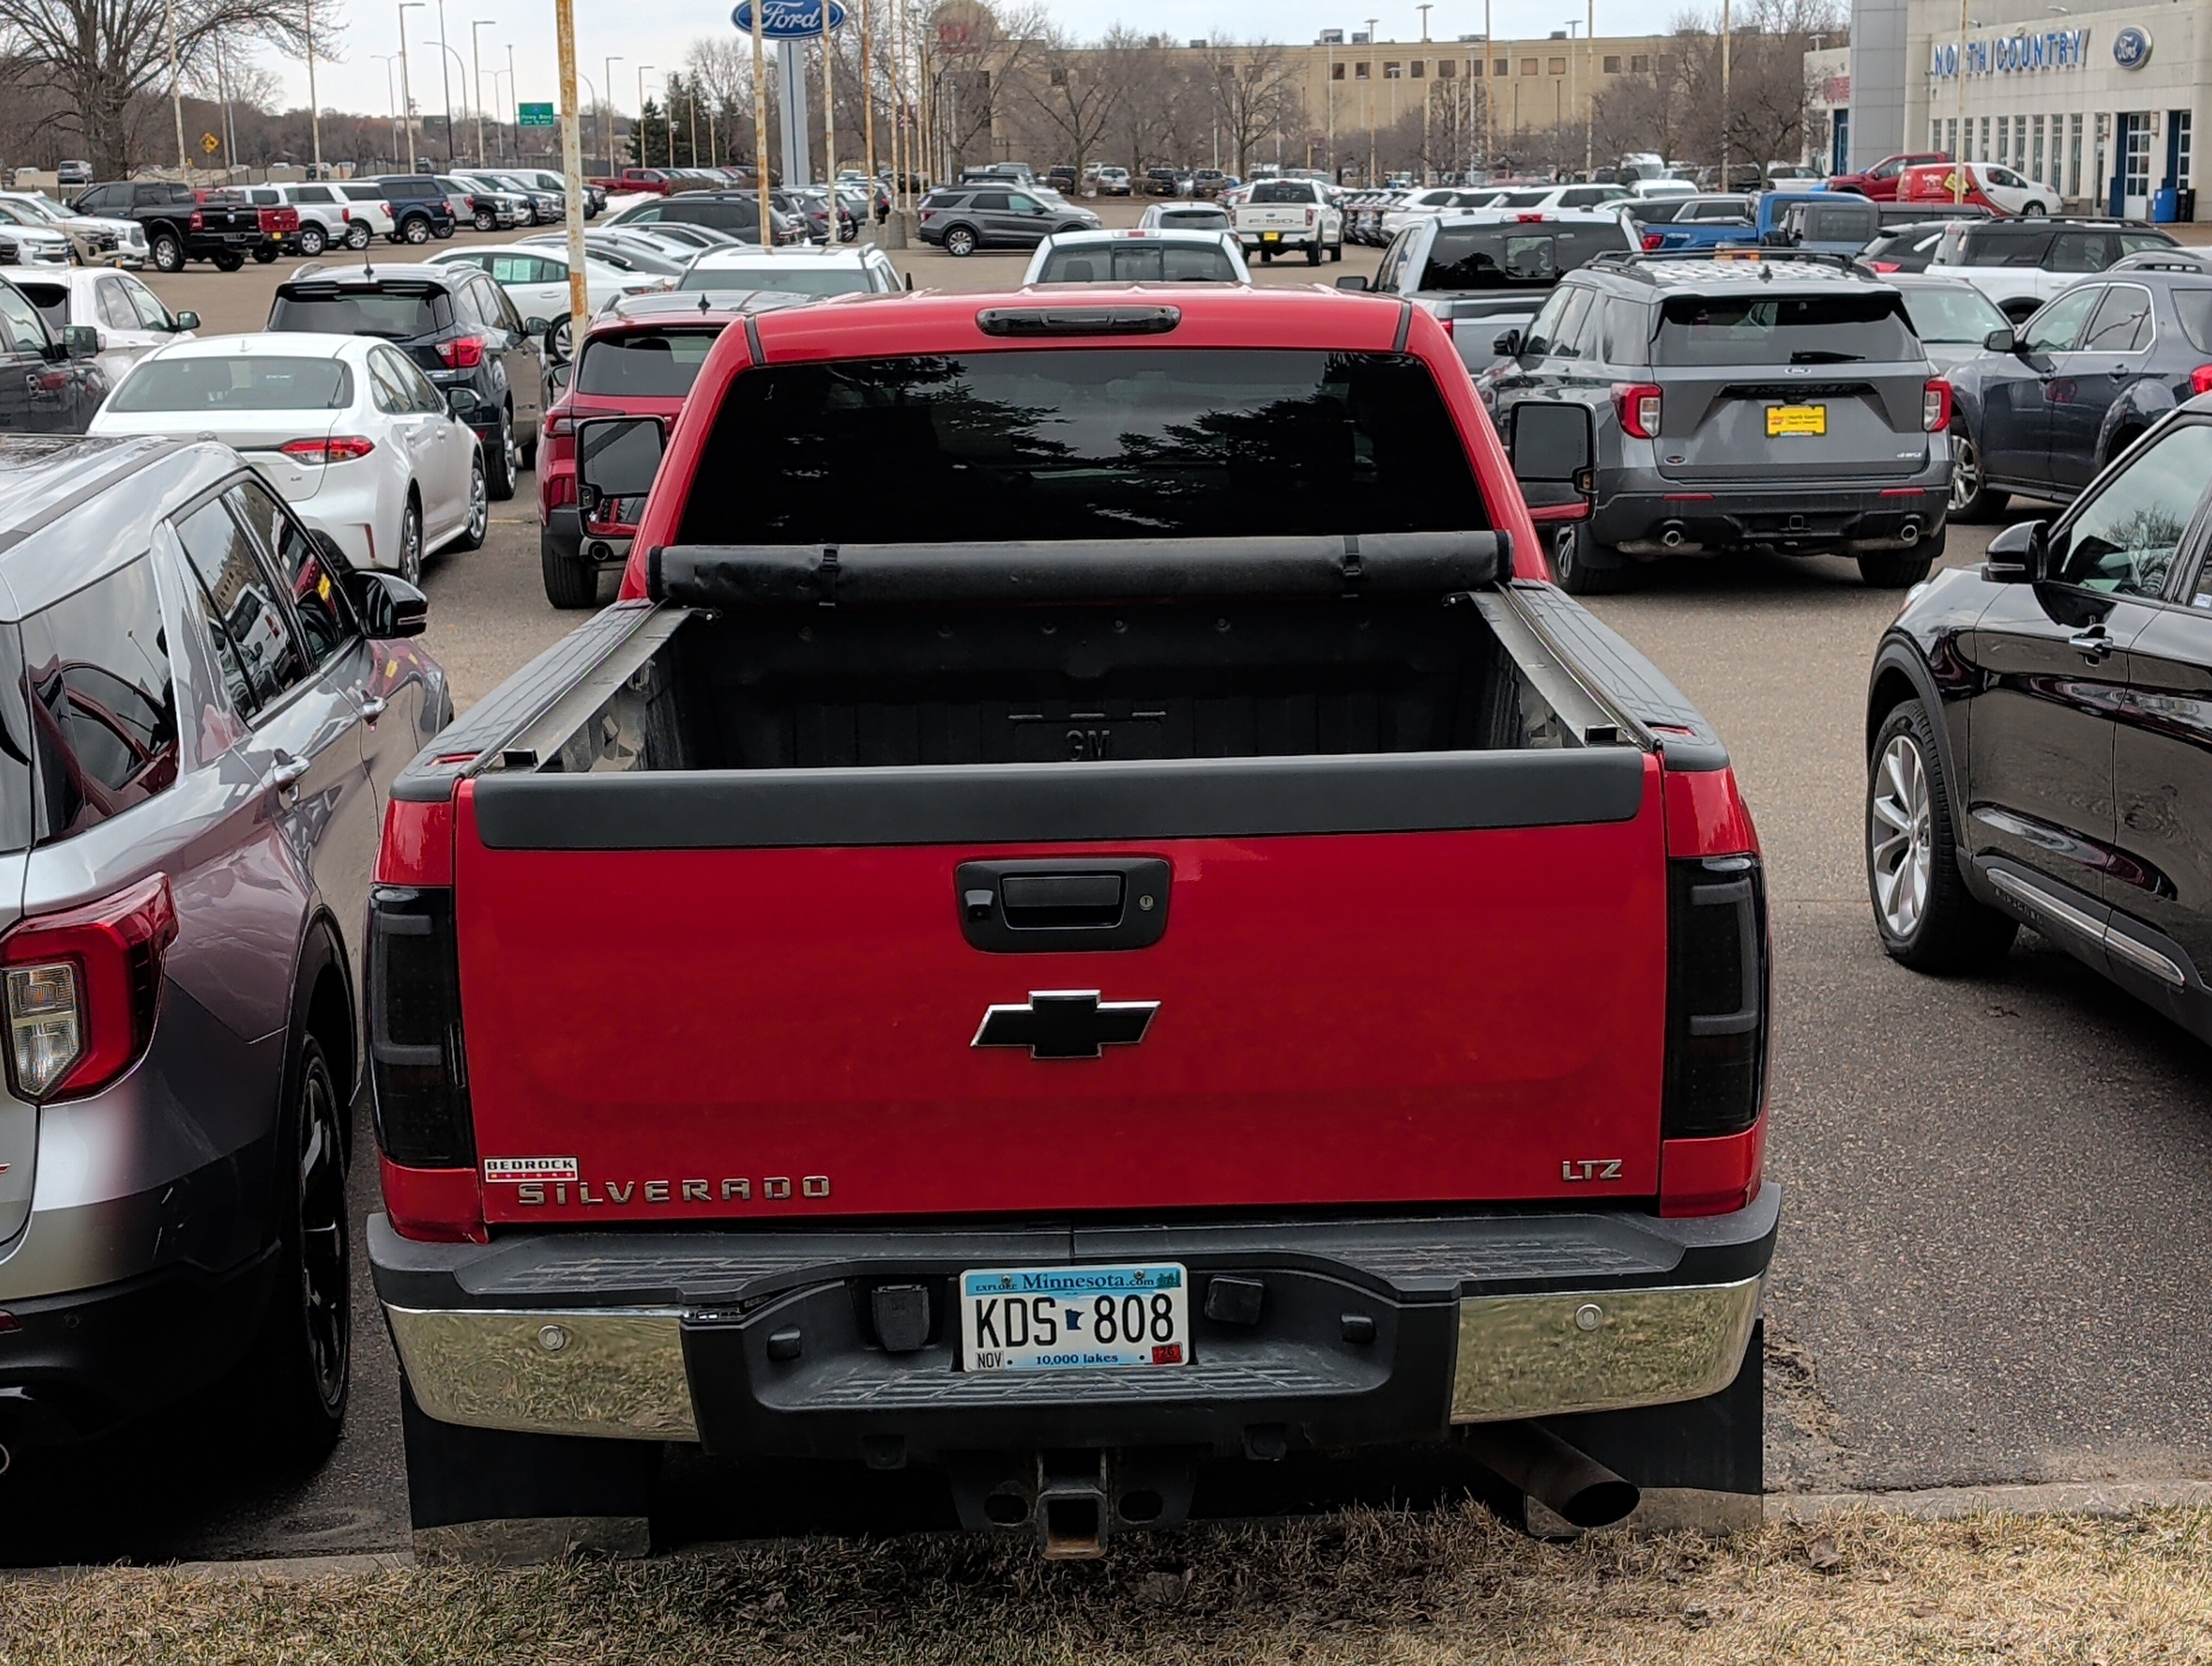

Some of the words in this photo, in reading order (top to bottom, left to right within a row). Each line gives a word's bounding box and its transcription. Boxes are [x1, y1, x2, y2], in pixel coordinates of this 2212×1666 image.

[762, 1, 821, 28] Ford
[1996, 29, 2082, 71] COUNTRY
[487, 1160, 574, 1170] BEDROCK
[1562, 1159, 1622, 1180] LTZ
[518, 1175, 829, 1204] SILVERADO
[976, 1297, 1057, 1348] KDS
[1094, 1293, 1174, 1344] 808
[978, 1353, 1002, 1368] NOV
[1037, 1354, 1079, 1366] 10,000
[1084, 1354, 1118, 1364] lakes
